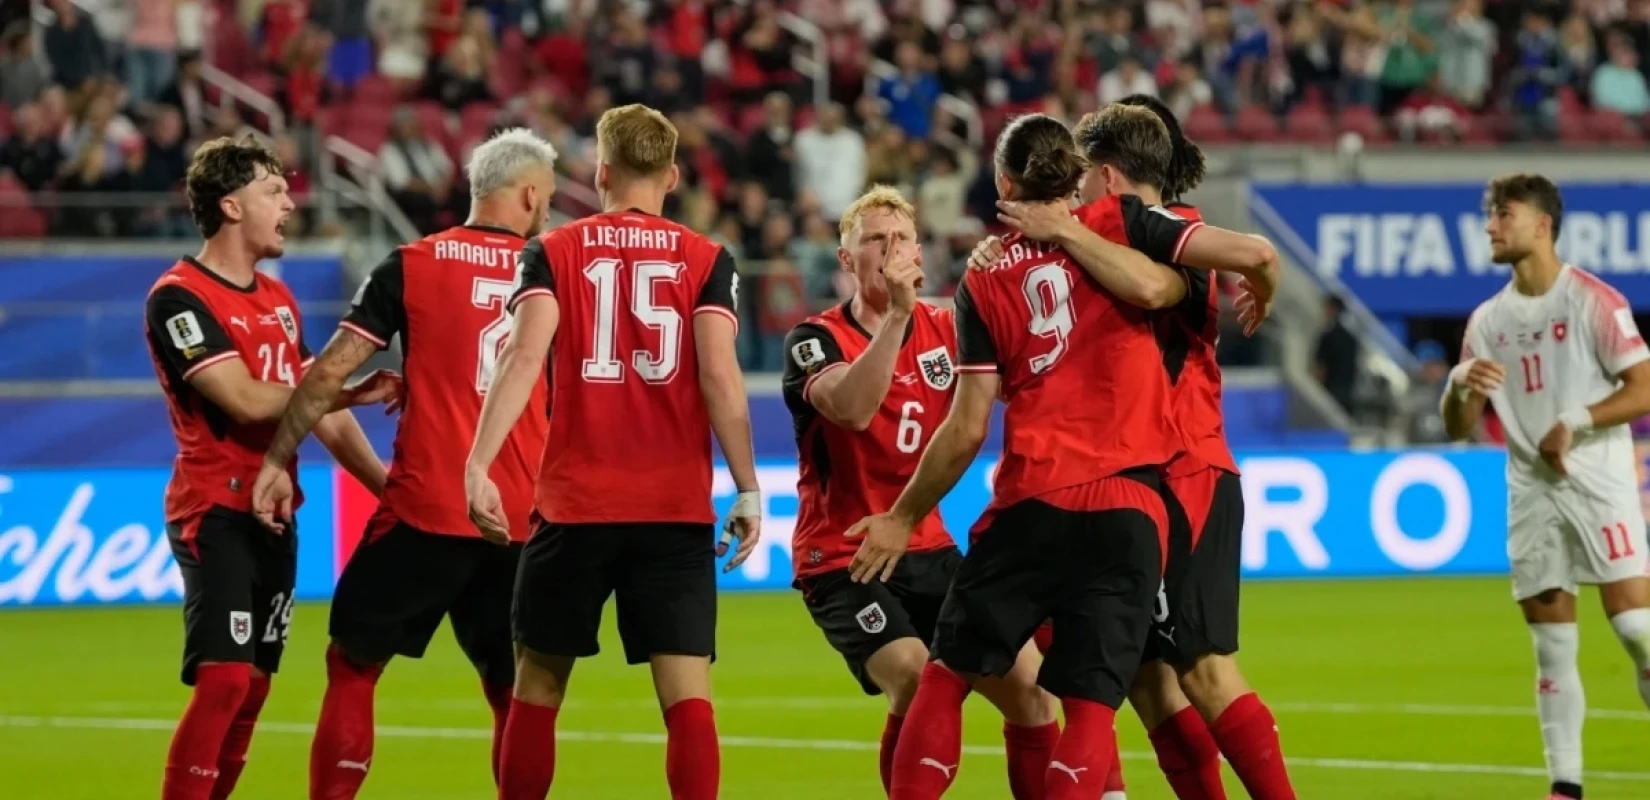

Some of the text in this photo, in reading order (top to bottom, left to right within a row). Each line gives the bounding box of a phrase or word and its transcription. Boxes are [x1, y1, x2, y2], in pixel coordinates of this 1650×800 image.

[583, 225, 681, 252] LIENHART
[1317, 210, 1650, 277] FIFA WRL
[582, 257, 687, 385] 15
[1022, 259, 1077, 375] 9
[1521, 353, 1544, 394] 11
[896, 401, 924, 454] 6
[1238, 452, 1472, 571] RO
[1601, 522, 1635, 561] 11
